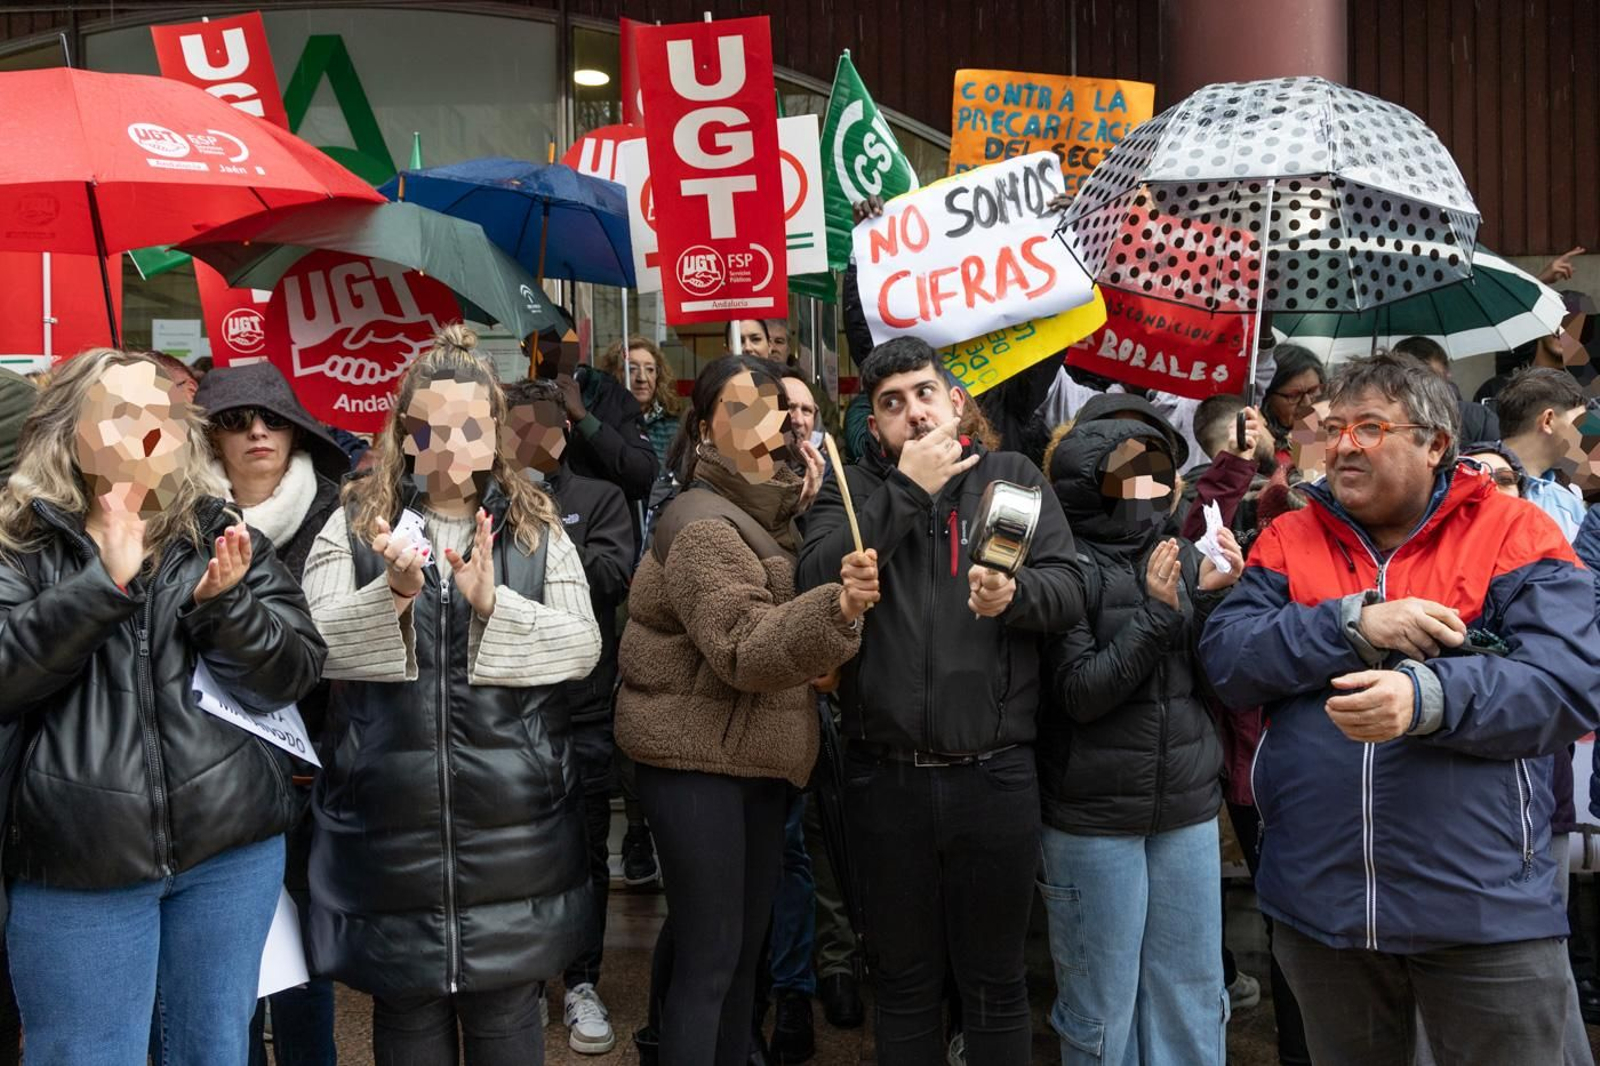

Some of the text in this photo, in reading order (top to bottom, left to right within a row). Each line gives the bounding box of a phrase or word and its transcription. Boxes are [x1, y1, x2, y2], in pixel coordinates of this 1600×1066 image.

[180, 27, 266, 118] UG
[961, 81, 1128, 113] CONTRA LA
[133, 127, 178, 144] UGT
[666, 35, 758, 240] UGT
[958, 106, 1132, 144] PRECARIZACI
[869, 204, 930, 264] NO
[944, 158, 1062, 239] SOMOS
[683, 254, 718, 275] UGT
[727, 253, 753, 268] FSP
[877, 235, 1058, 329] CIFRAS
[283, 258, 422, 348] UGT
[228, 316, 261, 335] UGT
[1070, 328, 1229, 383] BORALES
[332, 391, 399, 412] Andal
